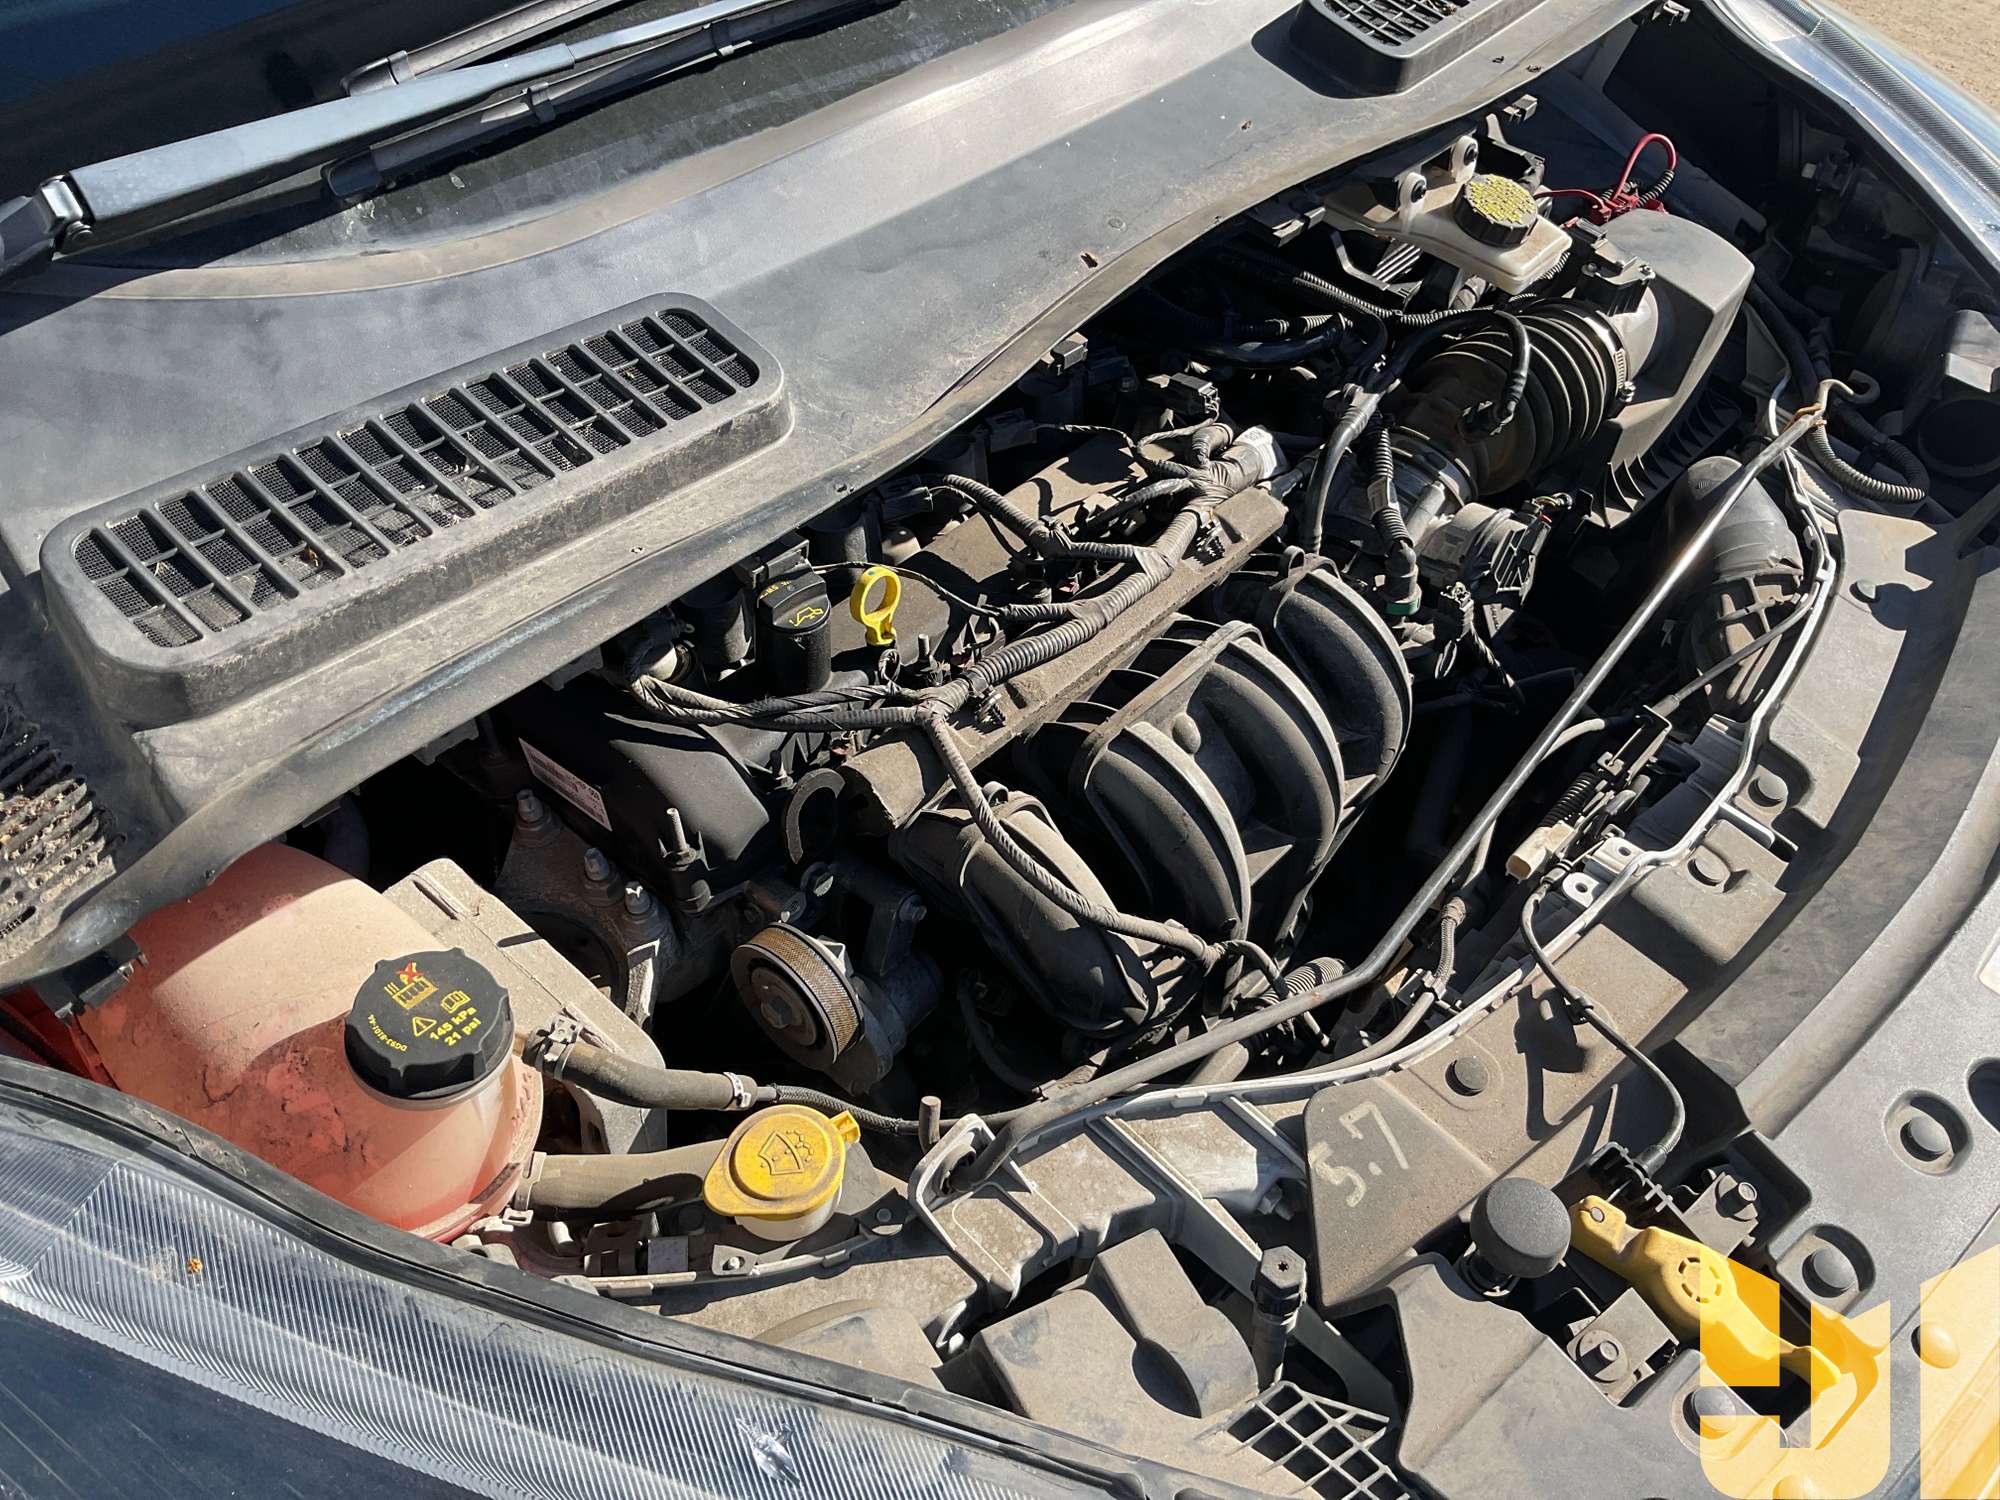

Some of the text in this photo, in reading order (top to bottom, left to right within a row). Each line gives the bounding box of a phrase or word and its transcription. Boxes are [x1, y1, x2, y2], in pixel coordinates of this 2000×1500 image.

[430, 1007, 477, 1040] 145 kPa
[445, 1018, 481, 1046] 21 psi
[1307, 1101, 1409, 1208] 5.7
